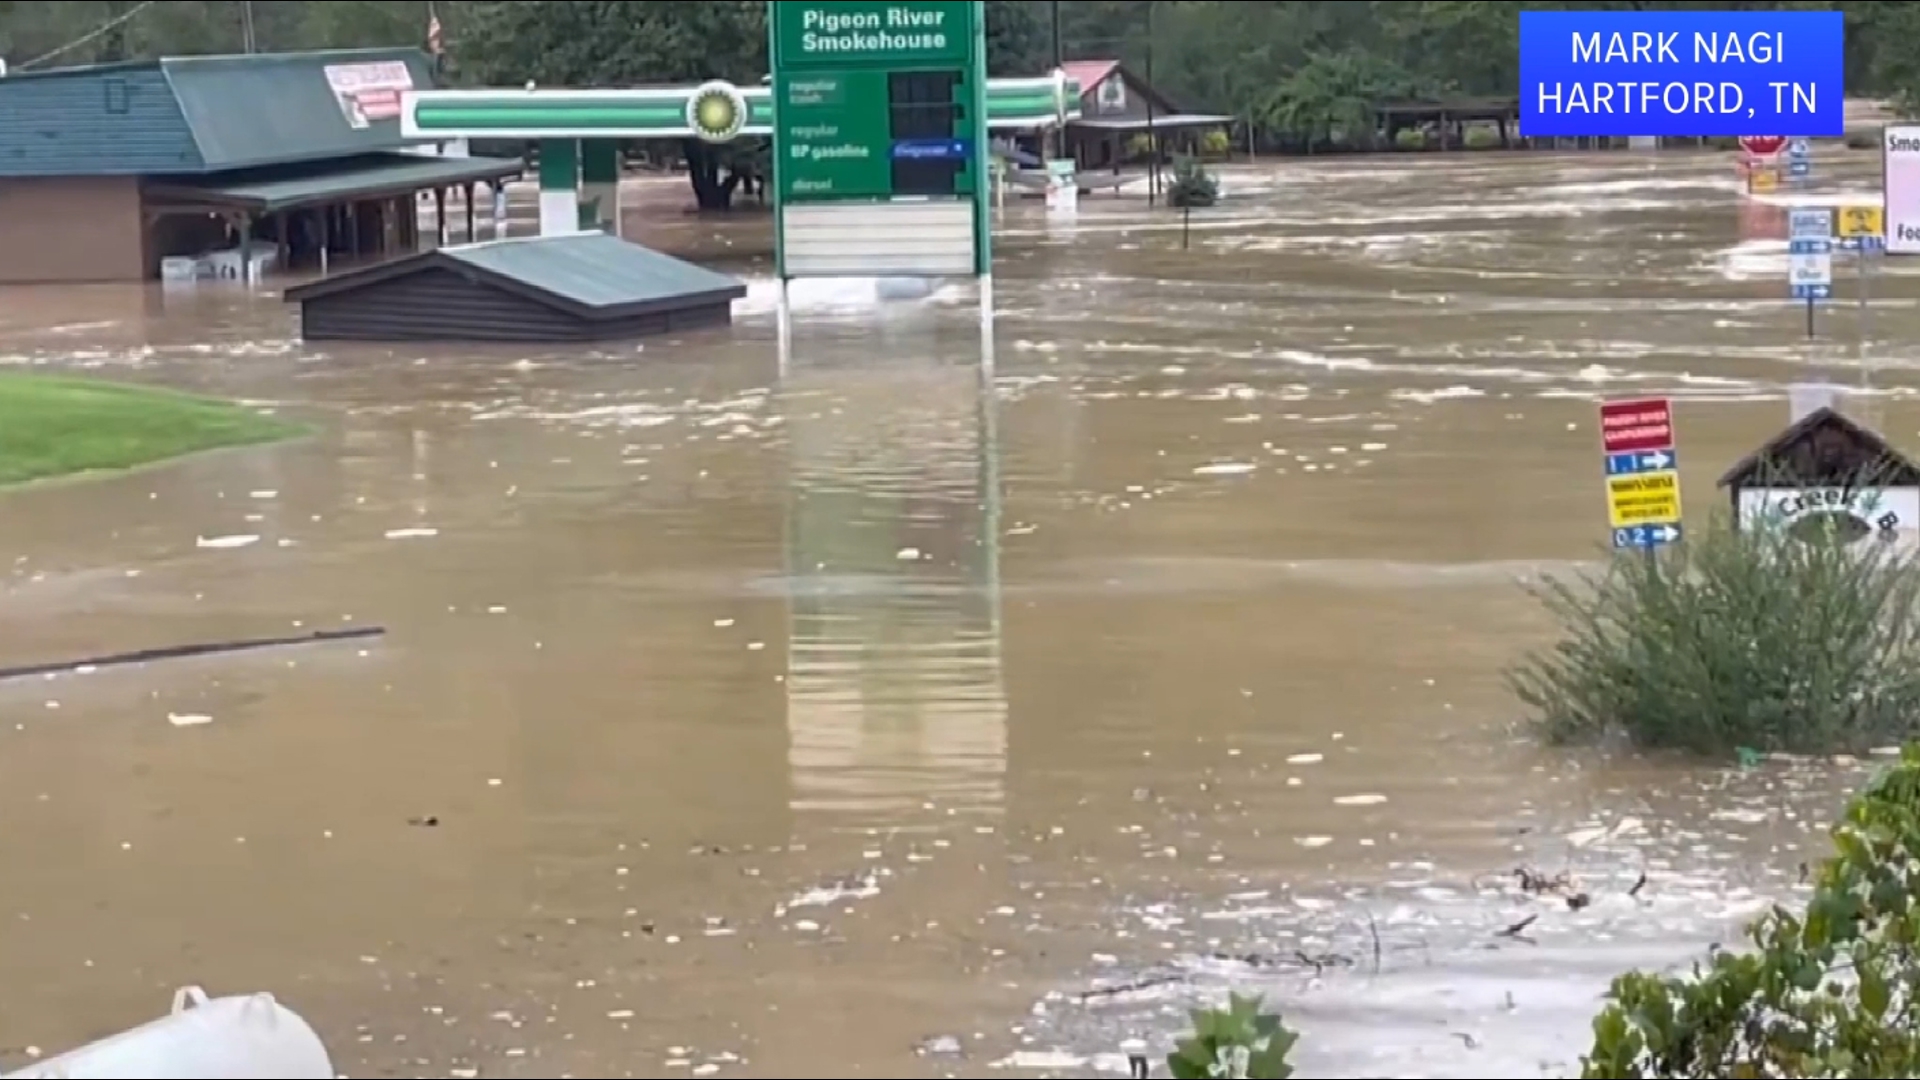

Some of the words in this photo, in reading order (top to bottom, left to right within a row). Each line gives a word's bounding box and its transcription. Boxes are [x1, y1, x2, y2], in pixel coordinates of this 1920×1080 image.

[803, 10, 880, 32] Pigeon
[887, 7, 946, 27] River
[802, 31, 946, 51] Smokehouse
[791, 144, 809, 158] BP
[811, 143, 870, 160] gasoline
